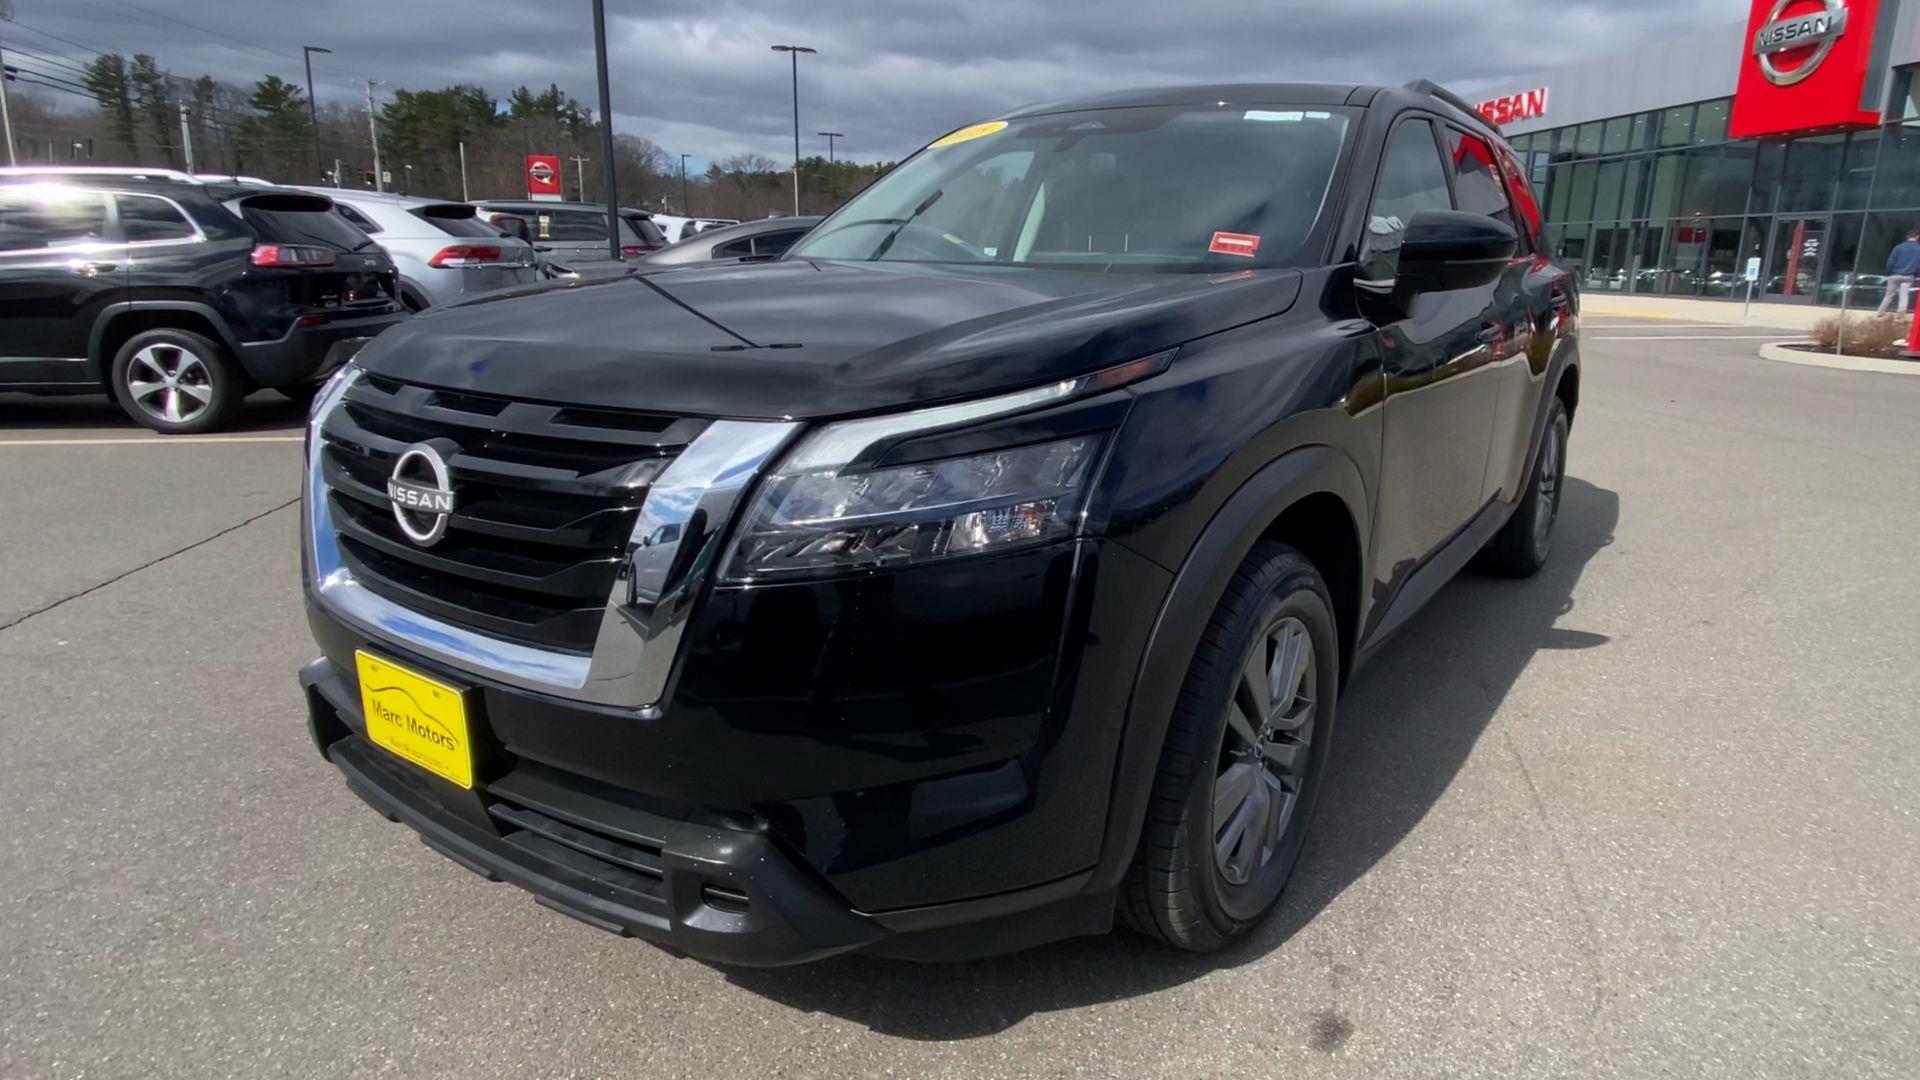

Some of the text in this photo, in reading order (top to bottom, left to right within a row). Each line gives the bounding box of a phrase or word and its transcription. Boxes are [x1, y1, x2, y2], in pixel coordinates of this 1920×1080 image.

[1761, 16, 1833, 46] NISSAN
[388, 481, 450, 510] NISSAN
[372, 698, 455, 751] Marc Motors
